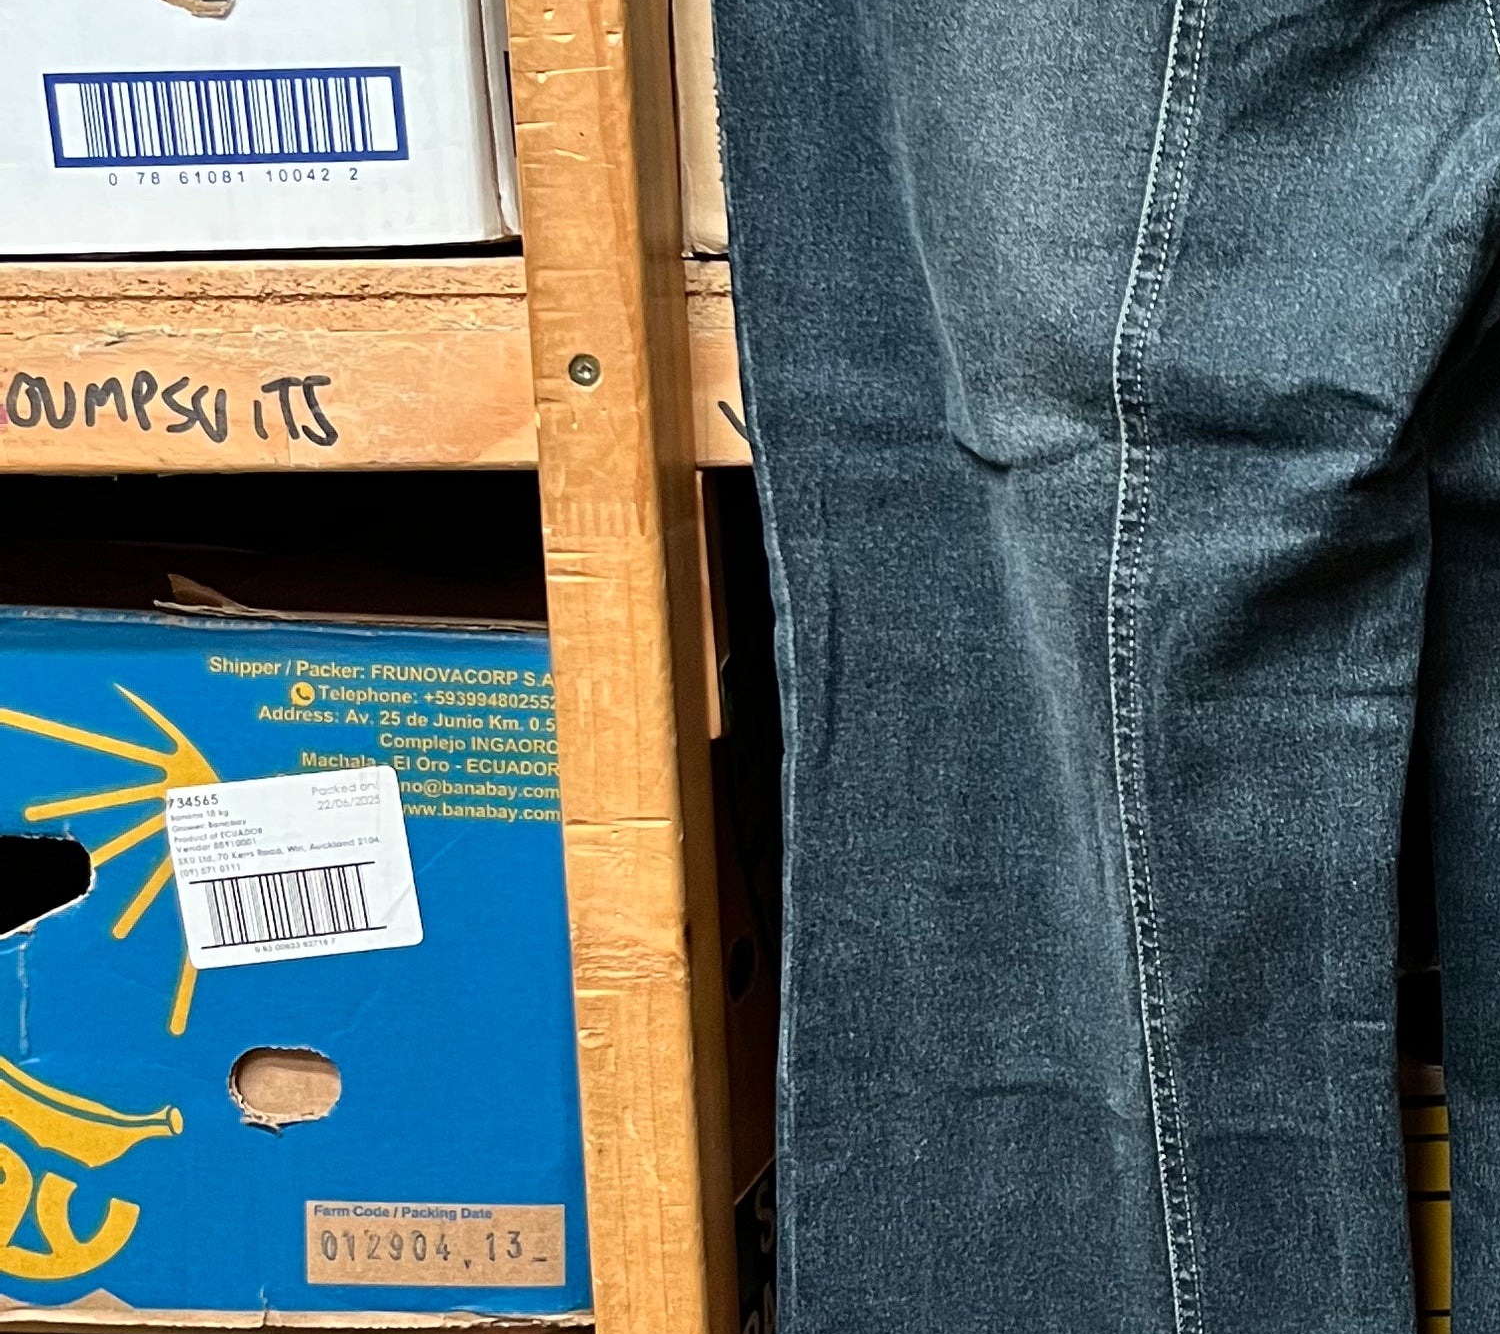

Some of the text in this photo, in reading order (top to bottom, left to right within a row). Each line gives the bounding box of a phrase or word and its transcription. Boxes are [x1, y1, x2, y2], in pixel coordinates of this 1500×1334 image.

[179, 168, 331, 186] 61081 10042
[209, 656, 518, 687] Shipper Packer: FRUNOVACORP
[317, 684, 418, 705] Telephone:
[258, 706, 484, 729] Address: 25 de Junio
[379, 733, 466, 753] Complejo
[416, 756, 450, 772] Oro
[466, 758, 560, 777] ECUADOR
[352, 1205, 493, 1221] Code Packing Date
